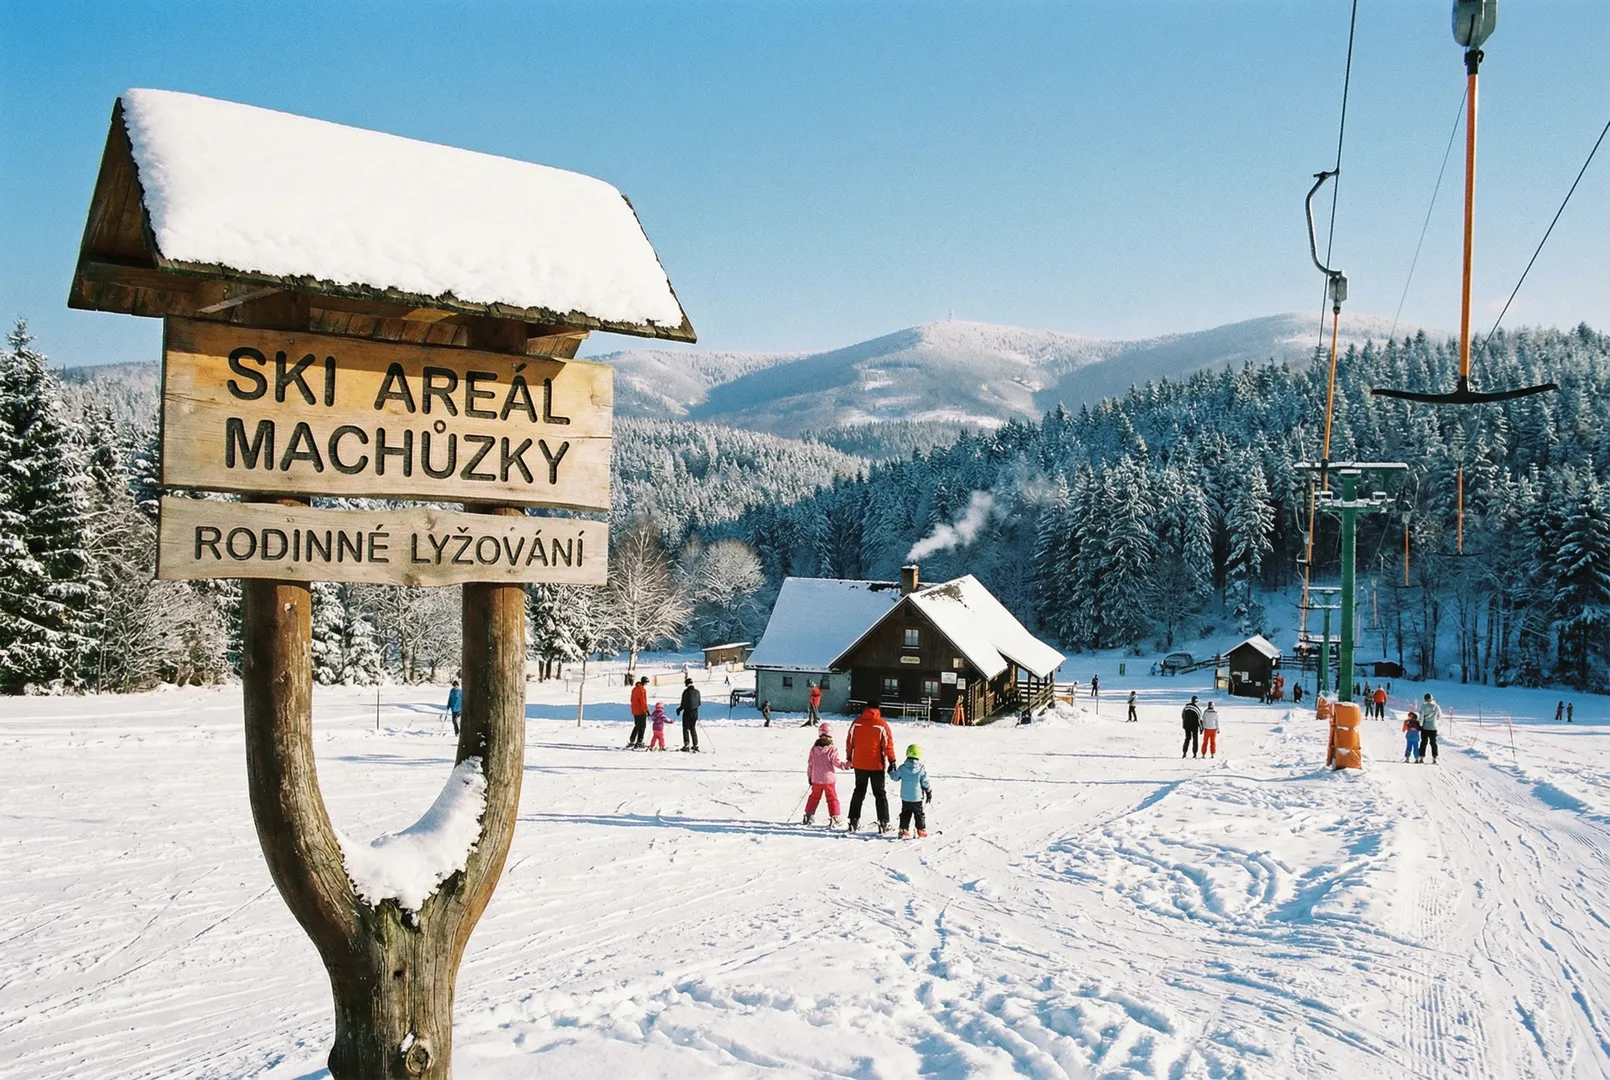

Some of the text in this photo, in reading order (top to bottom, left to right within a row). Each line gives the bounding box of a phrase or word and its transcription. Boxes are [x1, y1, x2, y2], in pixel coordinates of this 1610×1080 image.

[226, 346, 571, 426] SKI AREÁL
[225, 417, 571, 485] MACHŮZKY
[194, 524, 585, 568] RODINNÉ LYŽOVÁNÍ
